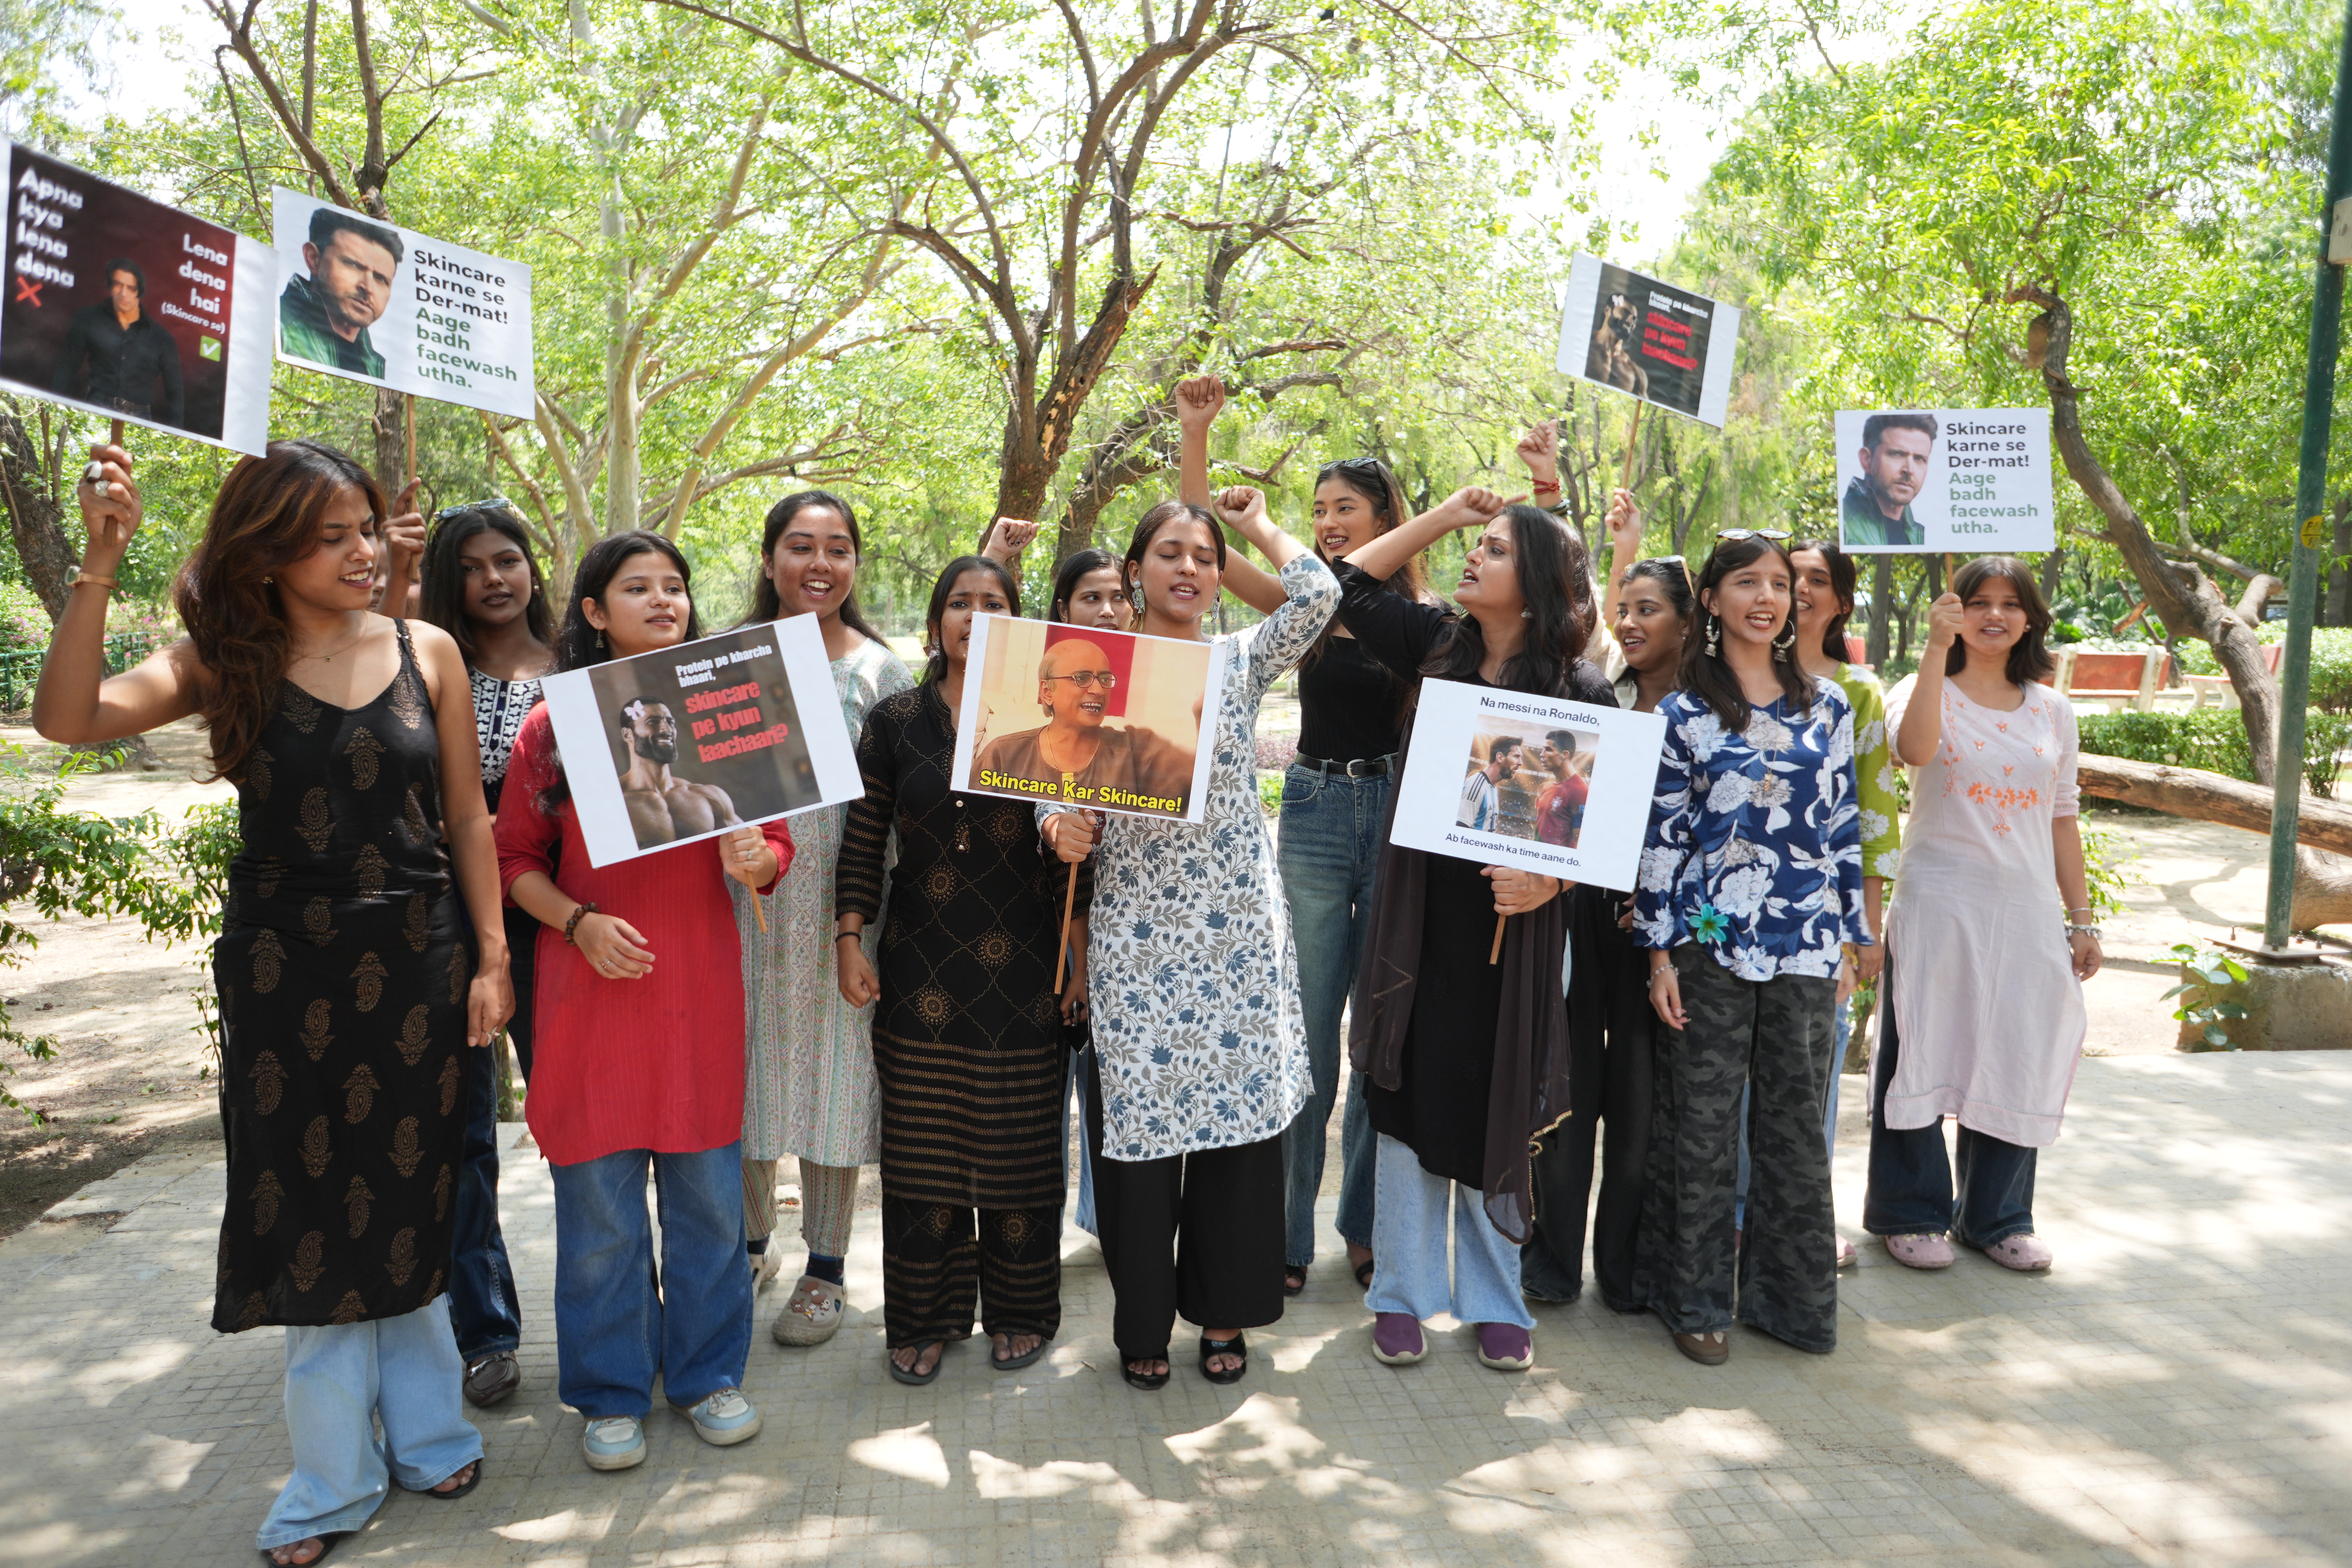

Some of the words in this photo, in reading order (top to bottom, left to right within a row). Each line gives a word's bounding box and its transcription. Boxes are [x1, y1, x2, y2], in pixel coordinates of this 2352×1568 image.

[17, 166, 83, 210] Apna
[18, 193, 63, 229] kya
[16, 221, 68, 258] lena
[183, 234, 228, 267] Lena
[14, 250, 75, 288] dena
[179, 262, 226, 291] dena
[414, 250, 505, 288] Skincare
[190, 288, 220, 314] hai
[415, 268, 475, 297] karne
[483, 291, 504, 305] se
[1650, 291, 1673, 305] Protein
[161, 302, 209, 327] (Skincare
[210, 321, 226, 335] se)
[416, 287, 508, 324] Der-mat!
[416, 307, 471, 332] Aage
[417, 324, 470, 351] badh
[1644, 327, 1658, 341] pe
[1647, 312, 1692, 337] skincare
[417, 344, 517, 381] facewash
[417, 365, 473, 388] utha.
[1946, 422, 2026, 435] Skincare
[1947, 439, 2000, 452] karne
[2006, 441, 2026, 451] se
[1949, 455, 2030, 467] Der-mat!
[1949, 472, 1996, 487] Aage
[1950, 488, 1996, 501] badh
[1950, 504, 2038, 517] facewash
[1952, 521, 1998, 533] utha.
[675, 659, 713, 677] Protein
[714, 656, 729, 668] pe
[729, 645, 772, 663] kharcha
[678, 670, 716, 688] bhaari,
[686, 681, 760, 714] skincare
[1480, 697, 1495, 708] Na
[1497, 700, 1531, 713] messi
[1533, 707, 1547, 716] na
[1549, 708, 1600, 726] Ronaldo,
[691, 718, 716, 740] pe
[716, 707, 762, 731] kyun
[697, 723, 789, 763] laachaari?
[979, 770, 1057, 795] Skincare
[1062, 781, 1095, 800] Kar
[1098, 786, 1182, 812] Skincare!
[1445, 833, 1459, 843] Ab
[1460, 835, 1504, 852] facewash
[1506, 844, 1517, 854] ka
[1519, 848, 1540, 859] time
[1541, 853, 1565, 863] aane
[1566, 856, 1581, 867] do.
